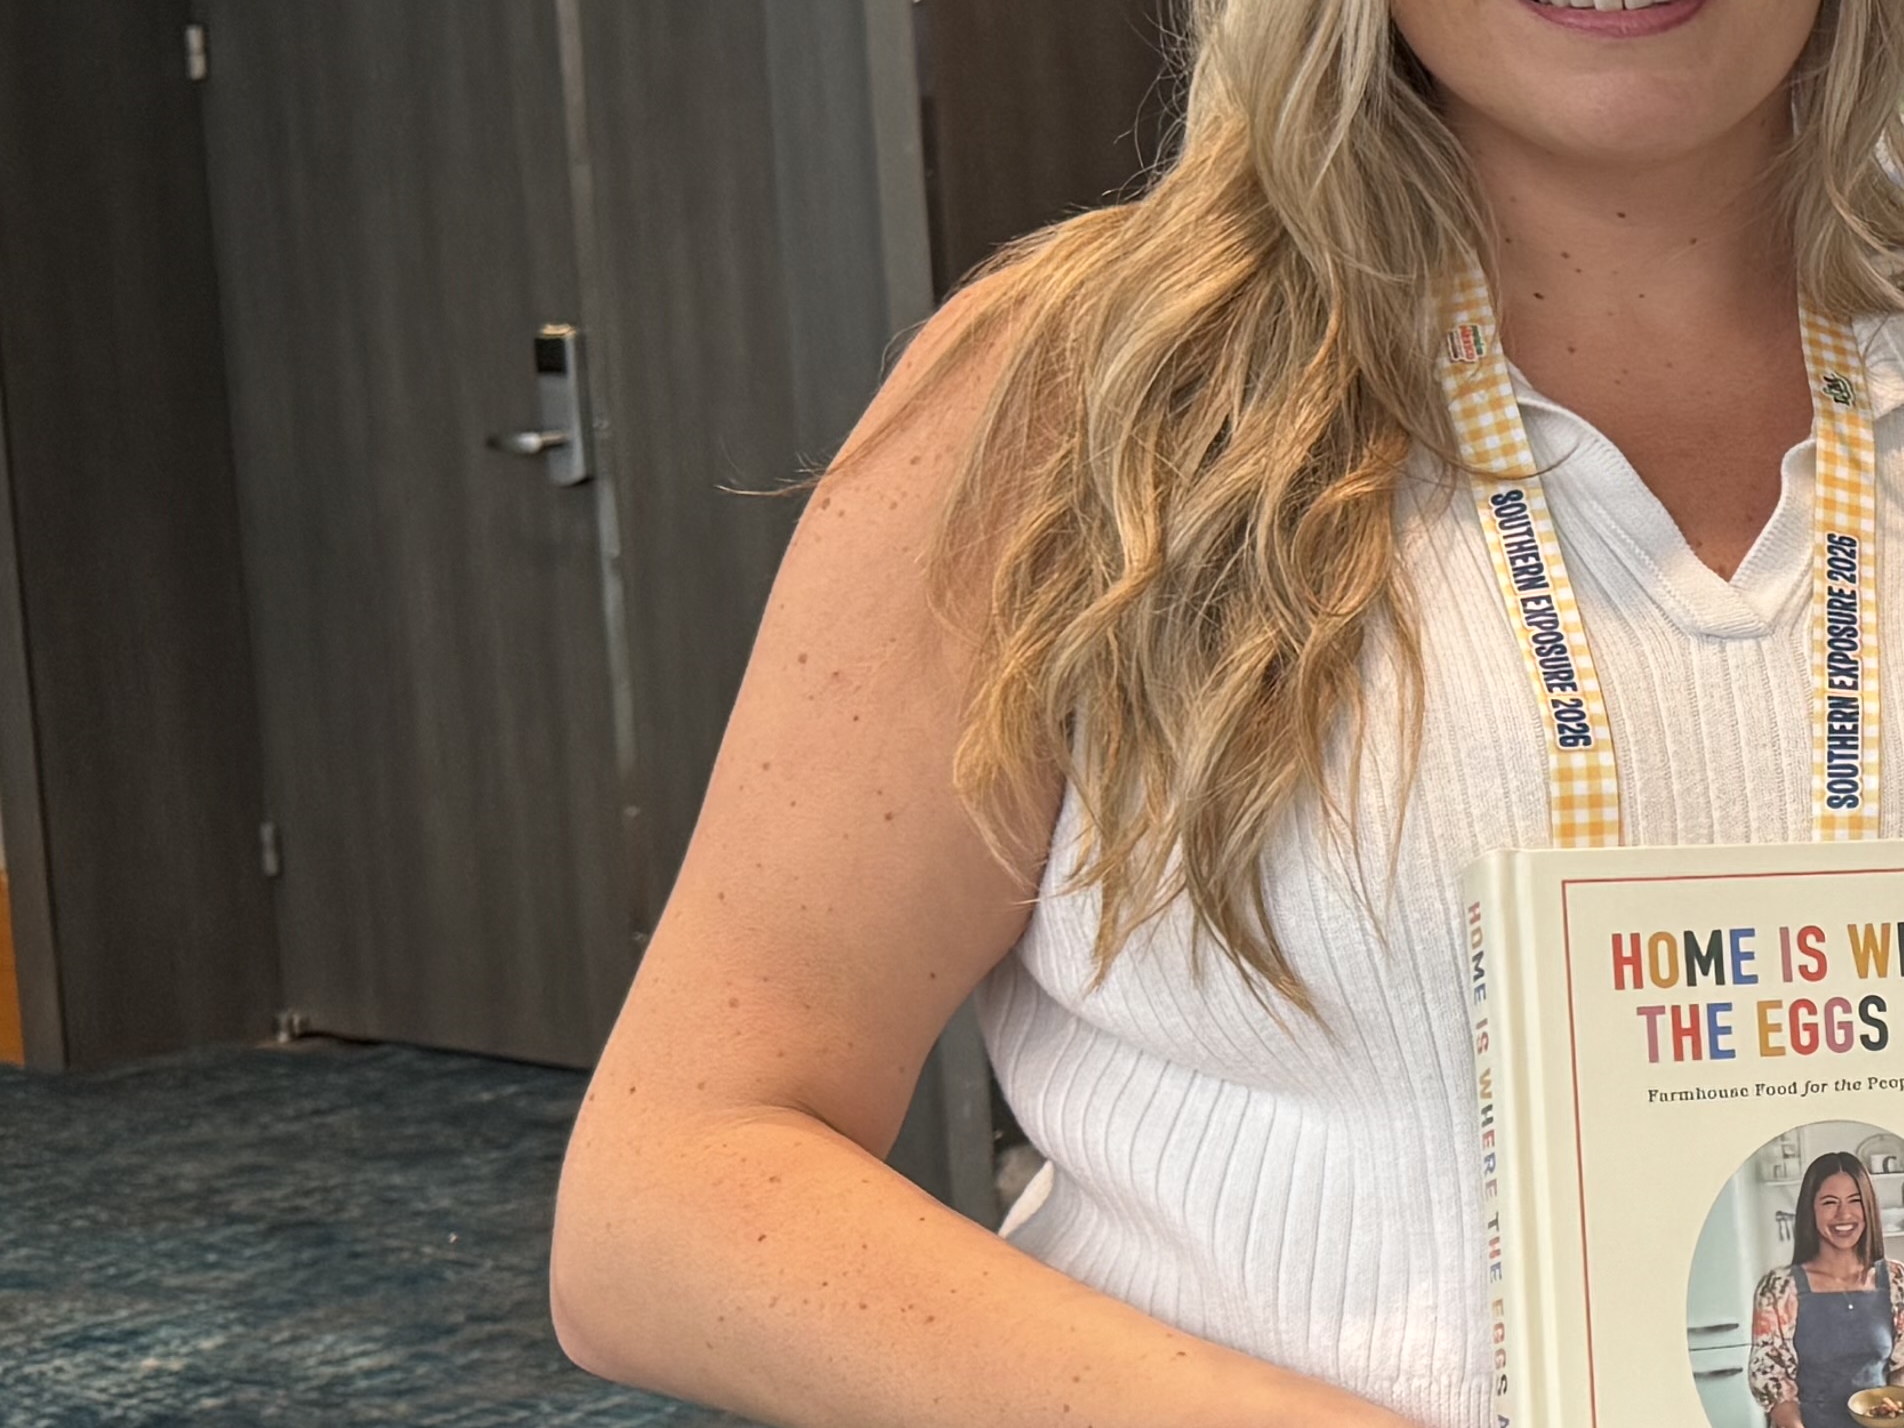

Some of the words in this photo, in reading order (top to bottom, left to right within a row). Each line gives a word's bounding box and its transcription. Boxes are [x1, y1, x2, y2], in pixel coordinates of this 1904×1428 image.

[1490, 488, 1550, 595] SOUTHERN
[1825, 533, 1859, 585] 2026
[1519, 593, 1579, 695] EXPOSURE
[1826, 585, 1860, 694] EXPOSURE
[1550, 692, 1593, 750] 2026
[1826, 694, 1860, 811] SOUTHERN
[1467, 901, 1487, 1006] HOME
[1611, 928, 1759, 990] HOME
[1779, 925, 1829, 983] IS
[1475, 1018, 1490, 1055] IS
[1636, 1002, 1737, 1063] THE
[1756, 994, 1889, 1058] EGGS
[1648, 1085, 1750, 1103] Farmhouse
[1755, 1081, 1797, 1097] Food
[1800, 1079, 1828, 1098] for
[1834, 1078, 1862, 1092] the
[1478, 1068, 1498, 1203] WHERE
[1487, 1211, 1503, 1284] THE
[1491, 1298, 1508, 1397] EGGS
